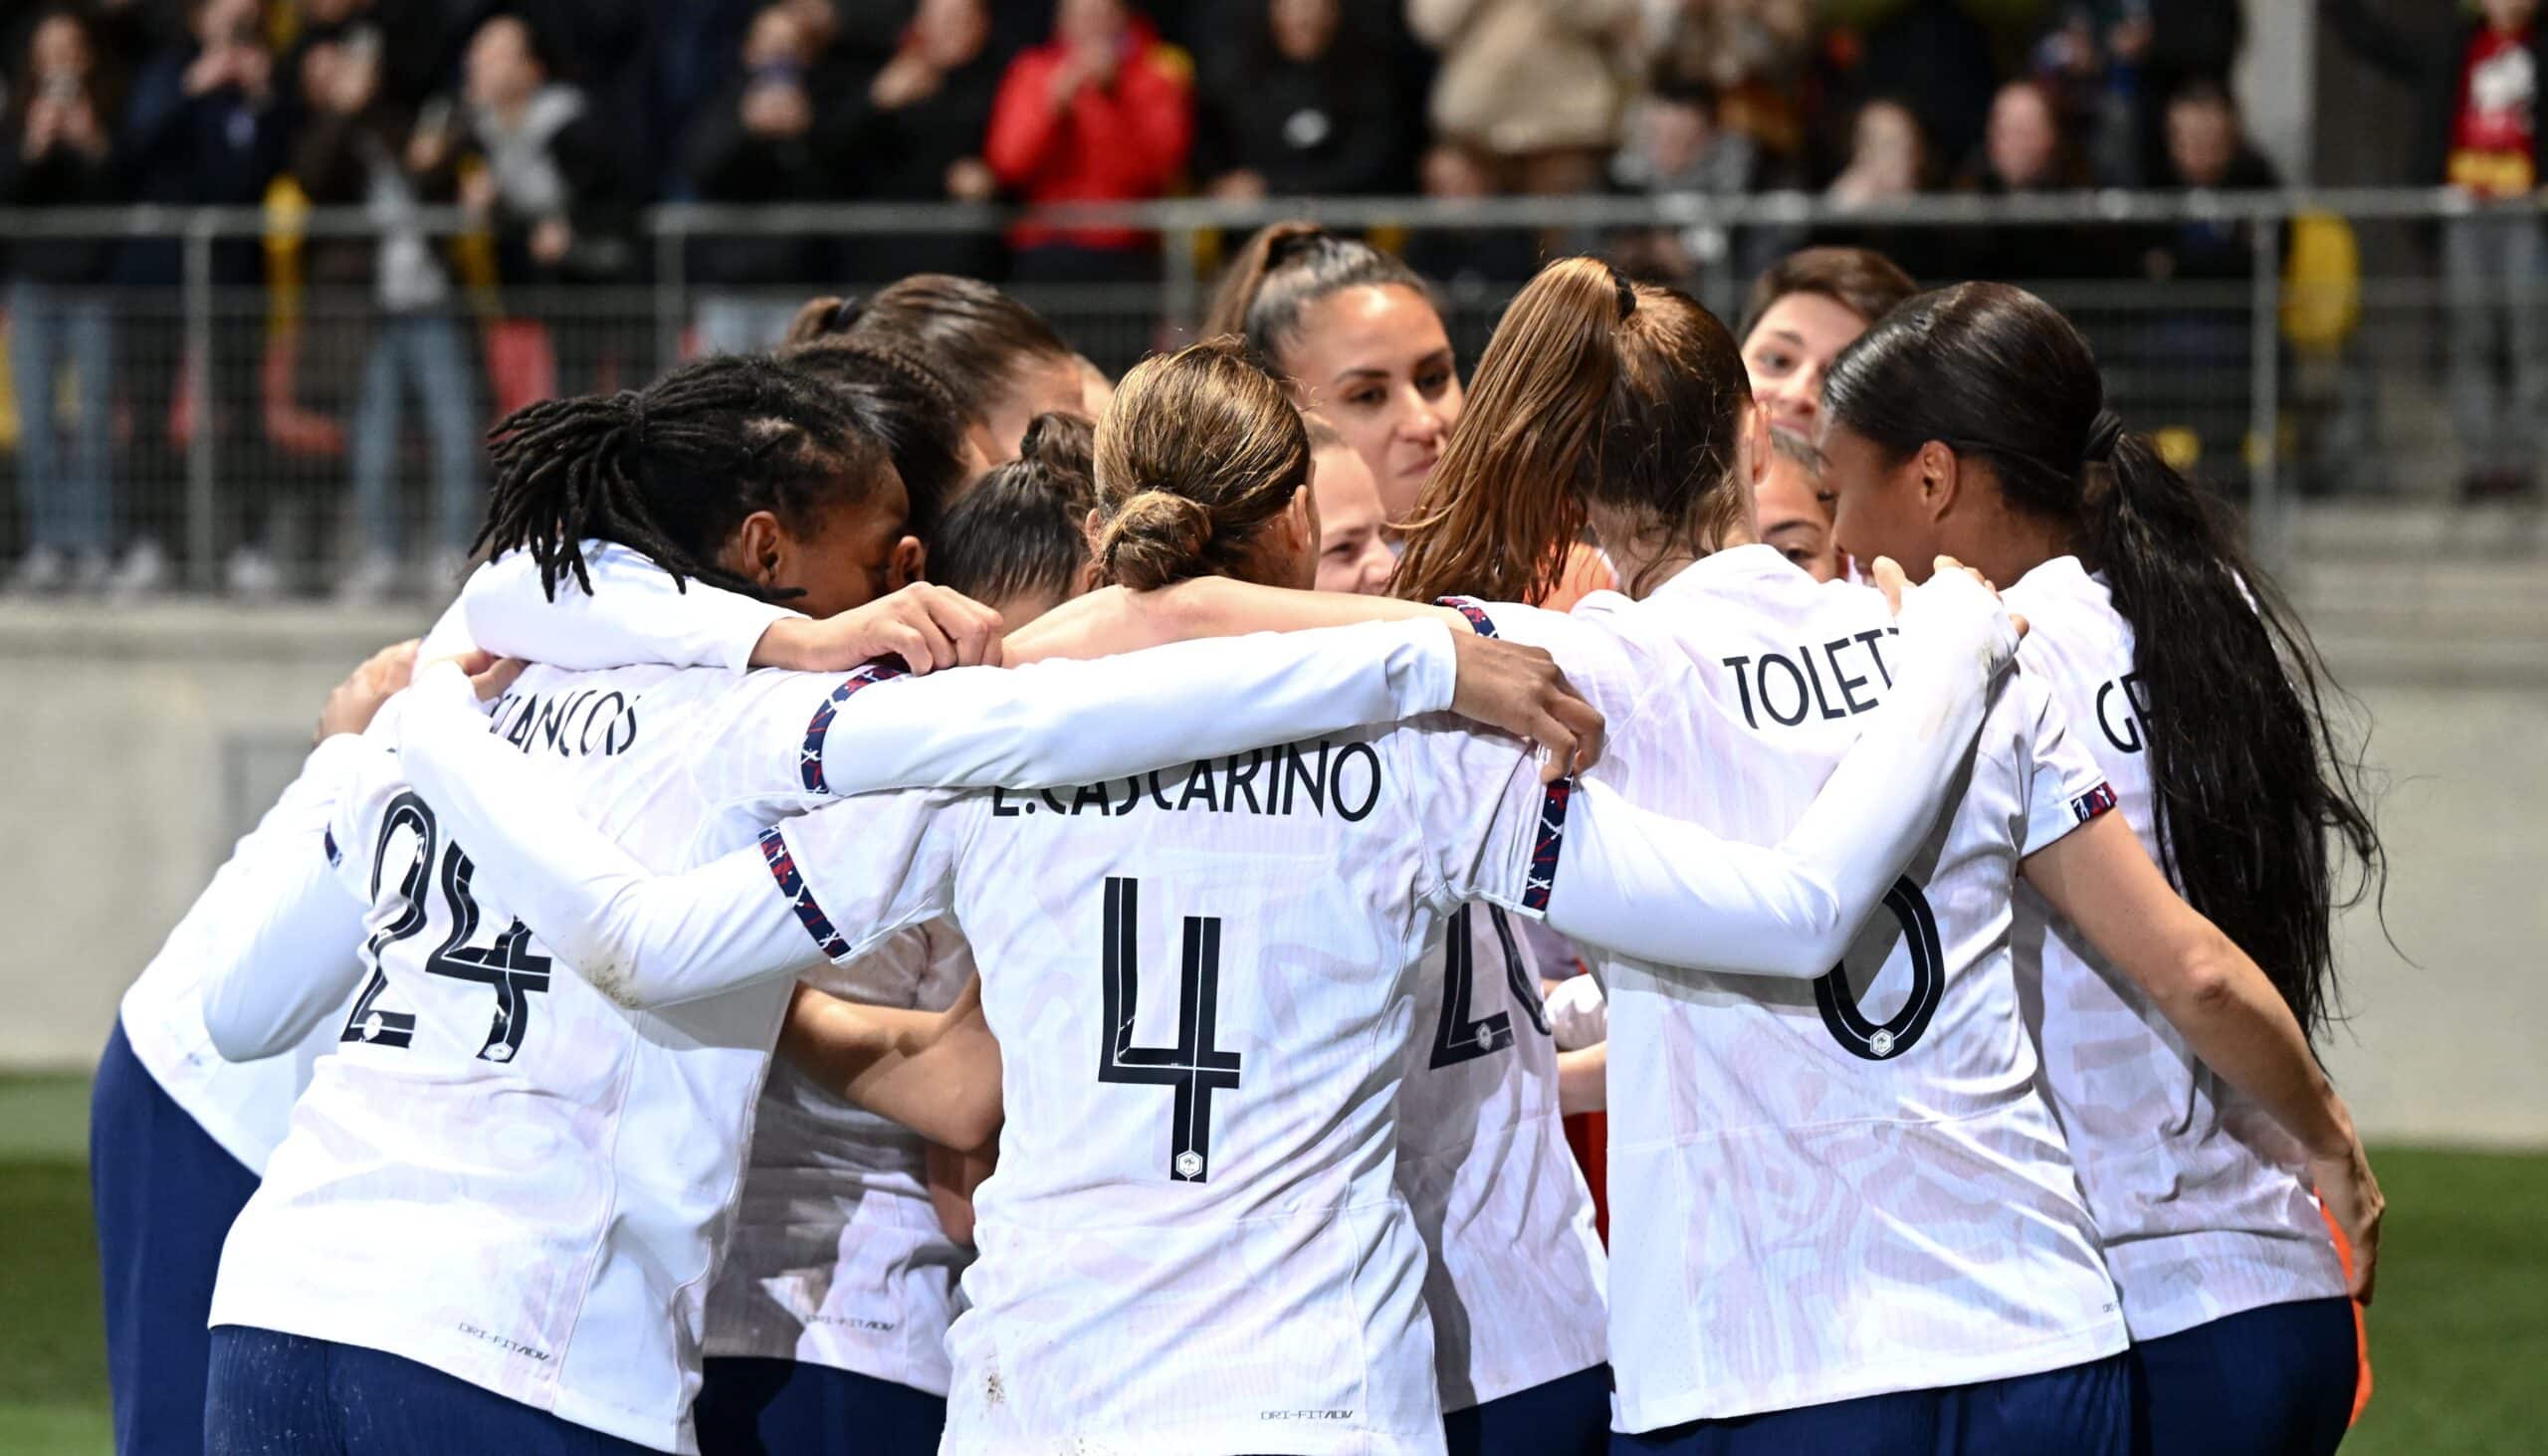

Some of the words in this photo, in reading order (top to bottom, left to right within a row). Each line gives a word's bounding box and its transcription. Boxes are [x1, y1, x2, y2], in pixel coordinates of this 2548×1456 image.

[1722, 627, 1900, 729] TOLET
[339, 791, 551, 1064] 24
[1098, 876, 1241, 1183] 4
